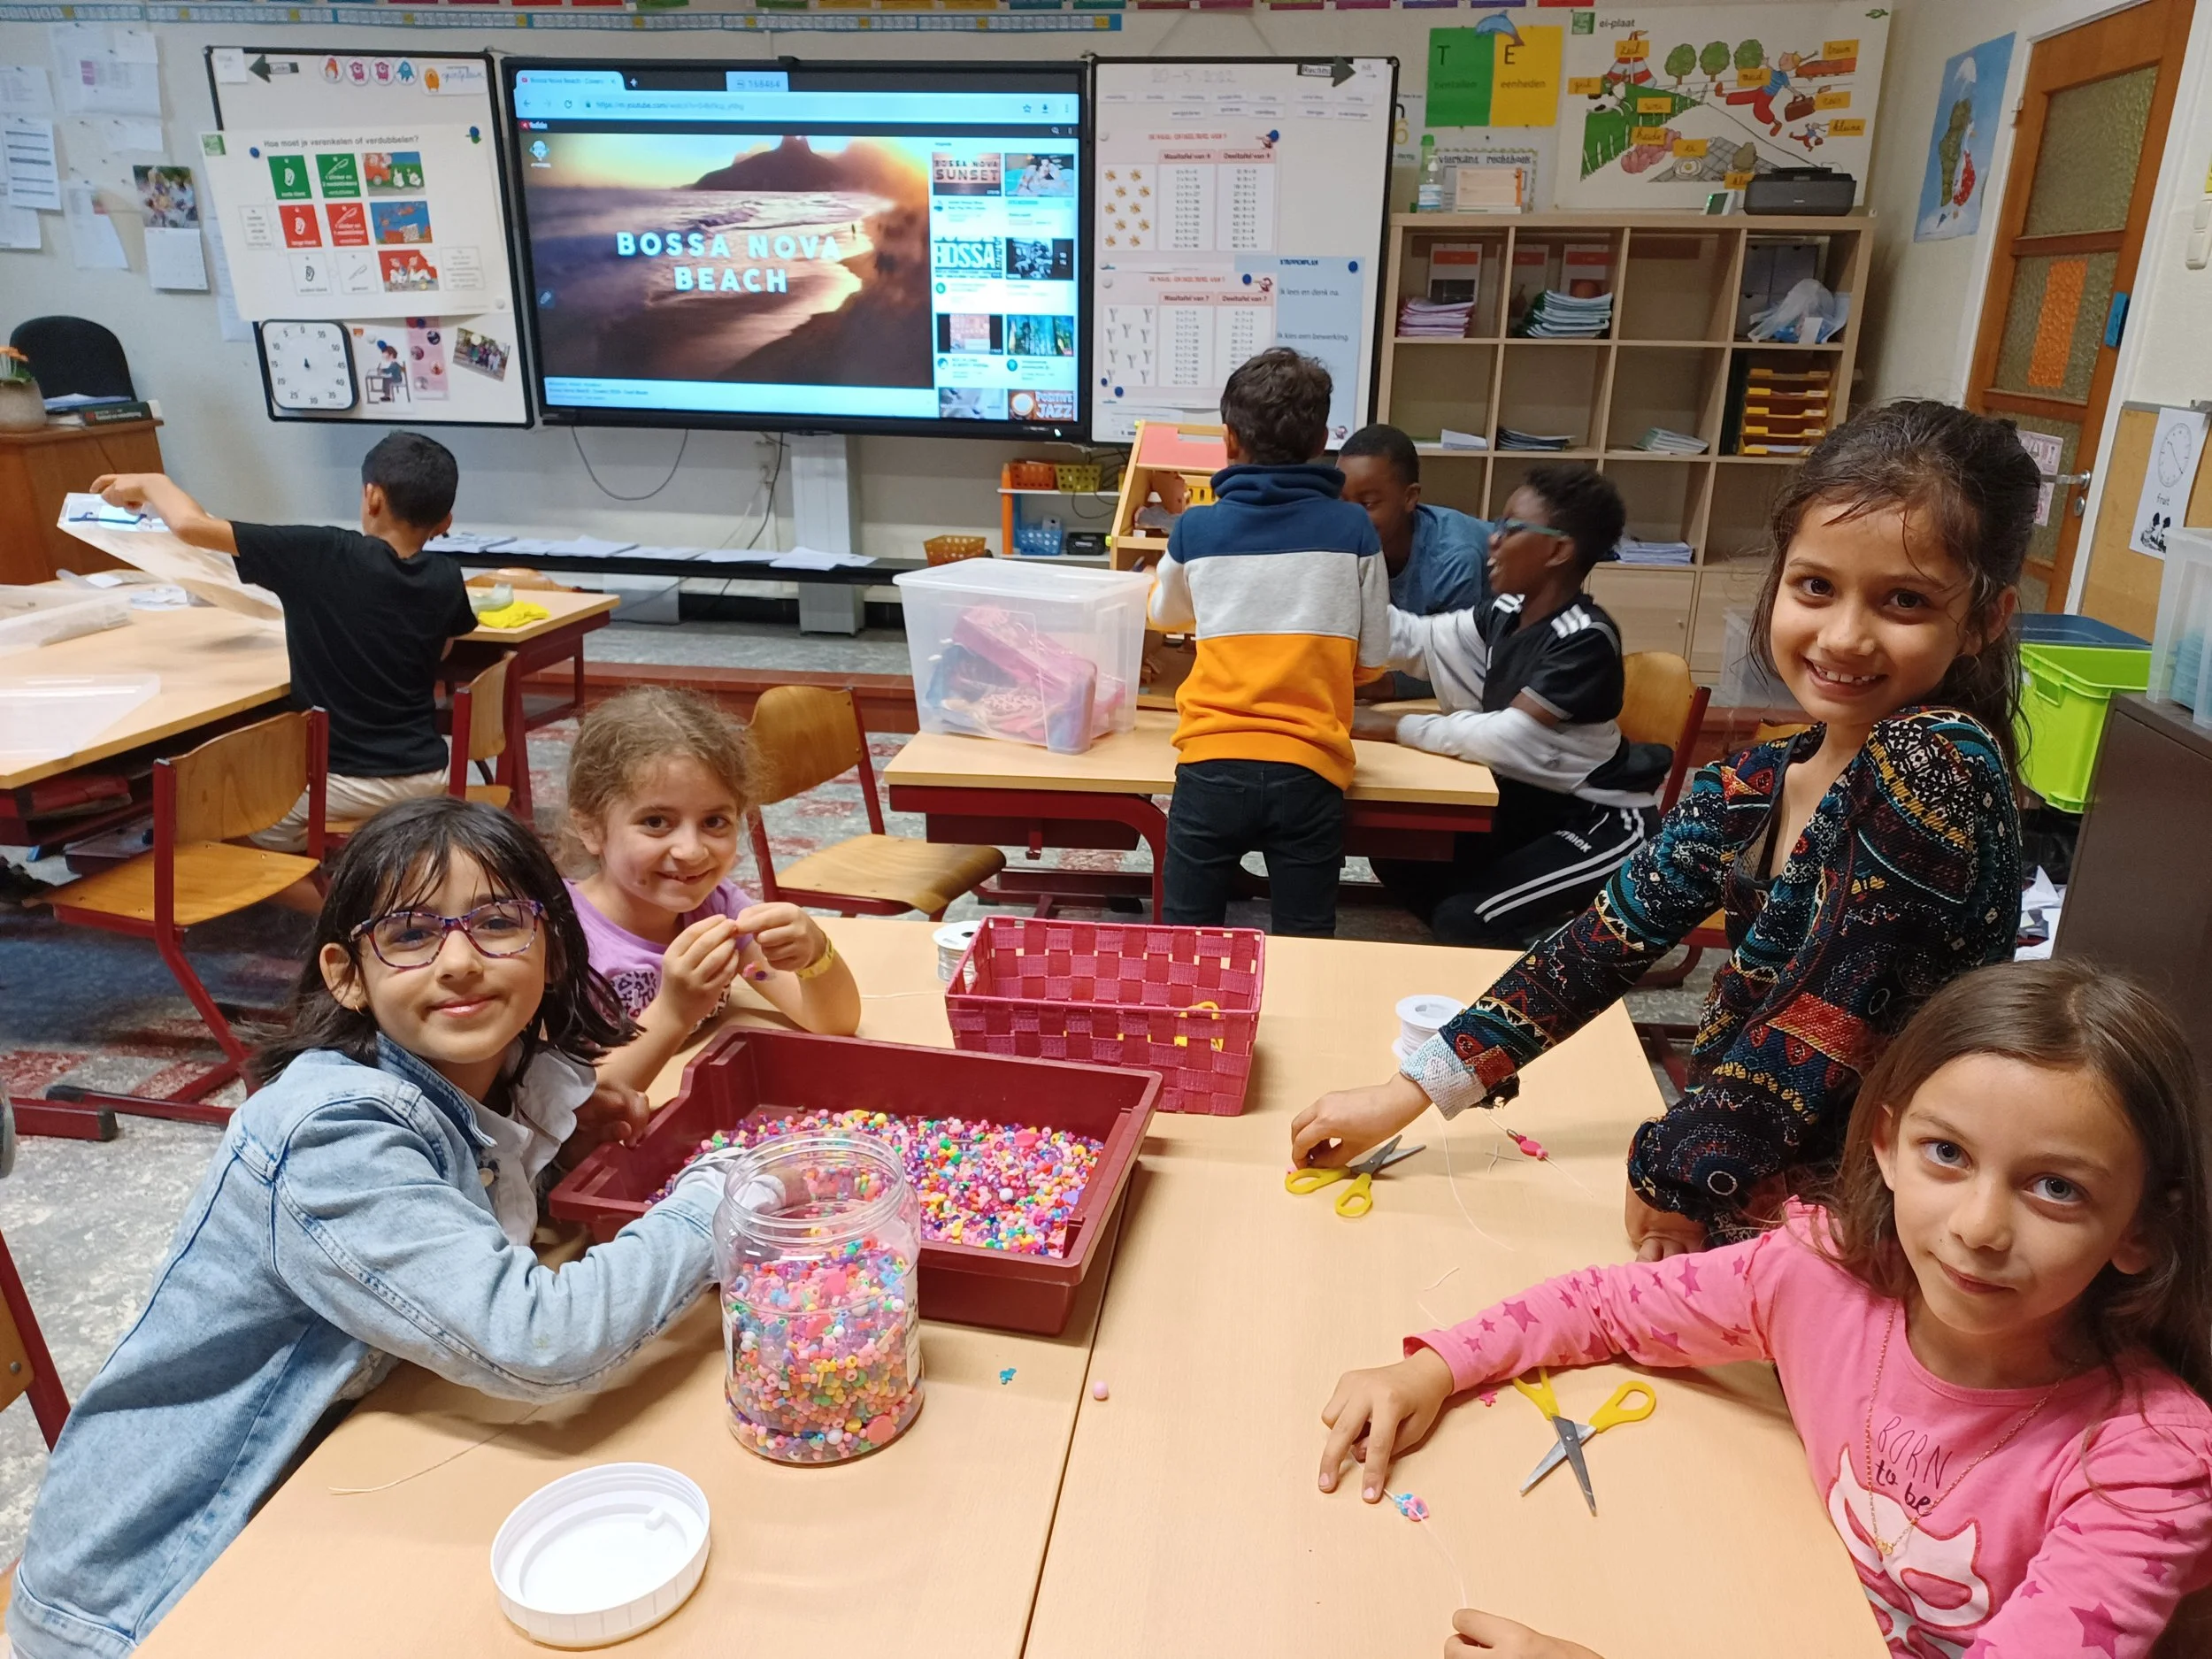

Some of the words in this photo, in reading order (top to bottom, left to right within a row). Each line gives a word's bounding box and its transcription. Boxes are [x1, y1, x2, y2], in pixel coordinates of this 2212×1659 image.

[1599, 19, 1635, 29] ei-plaat
[1437, 45, 1450, 65] T
[1504, 44, 1516, 65] E
[1501, 79, 1547, 88] eenheden
[302, 138, 309, 148] je
[365, 135, 419, 144] verdubbelen?
[1438, 155, 1479, 165] vierkant
[1486, 155, 1531, 165] rechthoek
[935, 169, 998, 181] SUNSET
[616, 231, 731, 259] BOSSA
[747, 234, 841, 261] NOVA
[933, 242, 996, 269] BOSSA
[673, 266, 787, 294] BEACH
[1036, 403, 1073, 419] JAZZ
[2155, 492, 2170, 506] fruit
[1878, 1416, 1954, 1490] BORN
[1874, 1459, 1899, 1487] to
[1903, 1481, 1933, 1517] be
